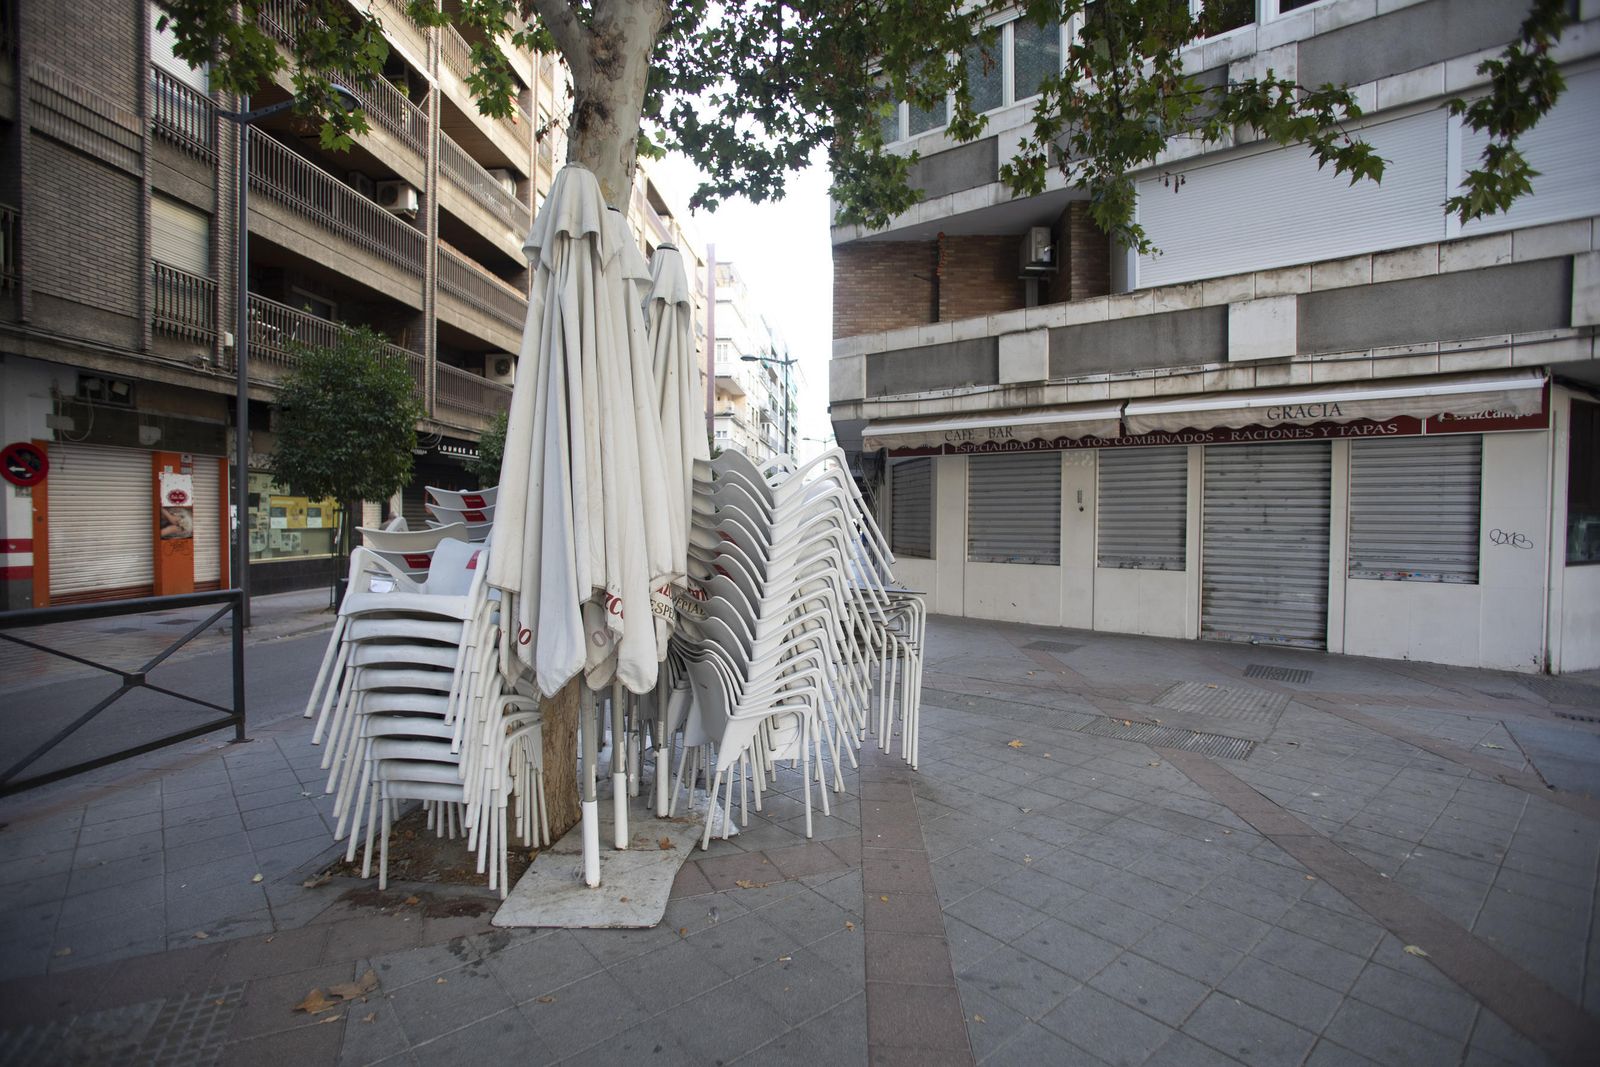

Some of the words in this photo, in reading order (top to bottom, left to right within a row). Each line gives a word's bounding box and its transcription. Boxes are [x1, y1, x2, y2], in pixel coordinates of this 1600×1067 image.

[1267, 403, 1343, 420] GRACIA
[955, 440, 1036, 453] ESPECIALIDAD
[1039, 440, 1054, 449] EN
[1059, 438, 1110, 448] PLATOS
[1115, 432, 1214, 445] COMBINADOS
[1230, 428, 1314, 441] RACIONES
[1320, 427, 1331, 437] Y
[1336, 423, 1398, 436] TAPAS
[988, 426, 1014, 439] BAR
